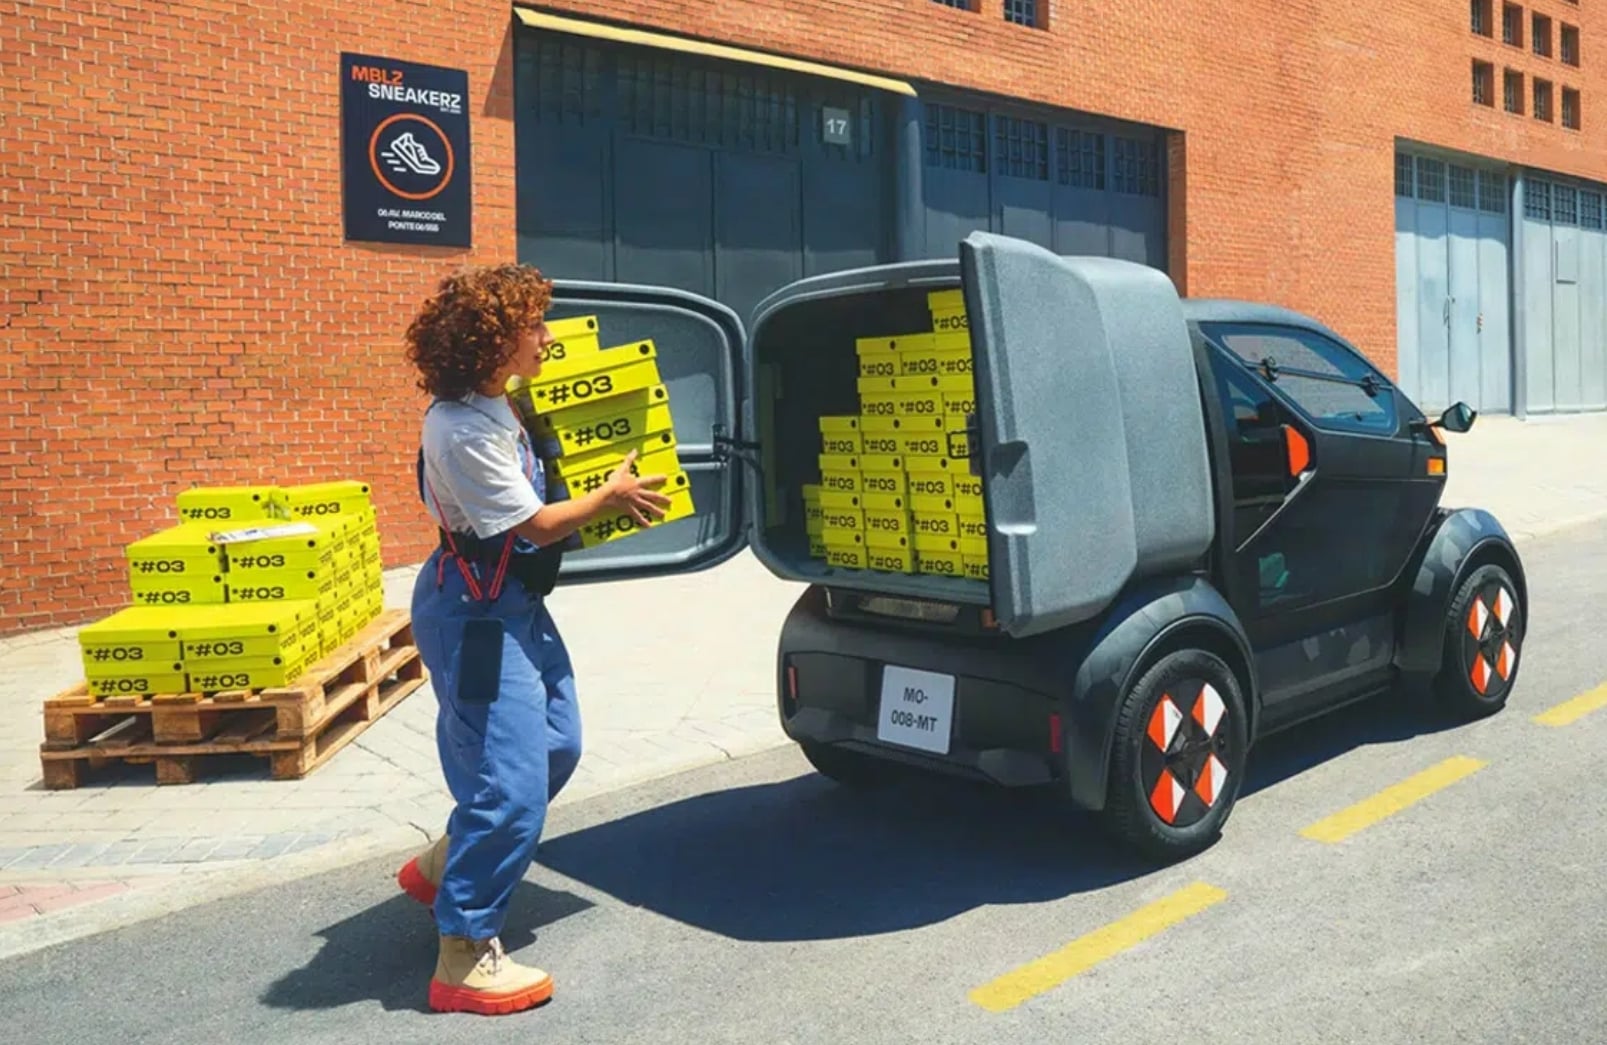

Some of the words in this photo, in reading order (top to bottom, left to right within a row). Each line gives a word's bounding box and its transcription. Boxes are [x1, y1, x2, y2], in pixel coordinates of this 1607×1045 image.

[827, 119, 847, 135] 17
[904, 687, 928, 704] MO-
[891, 709, 938, 732] 008-MT
